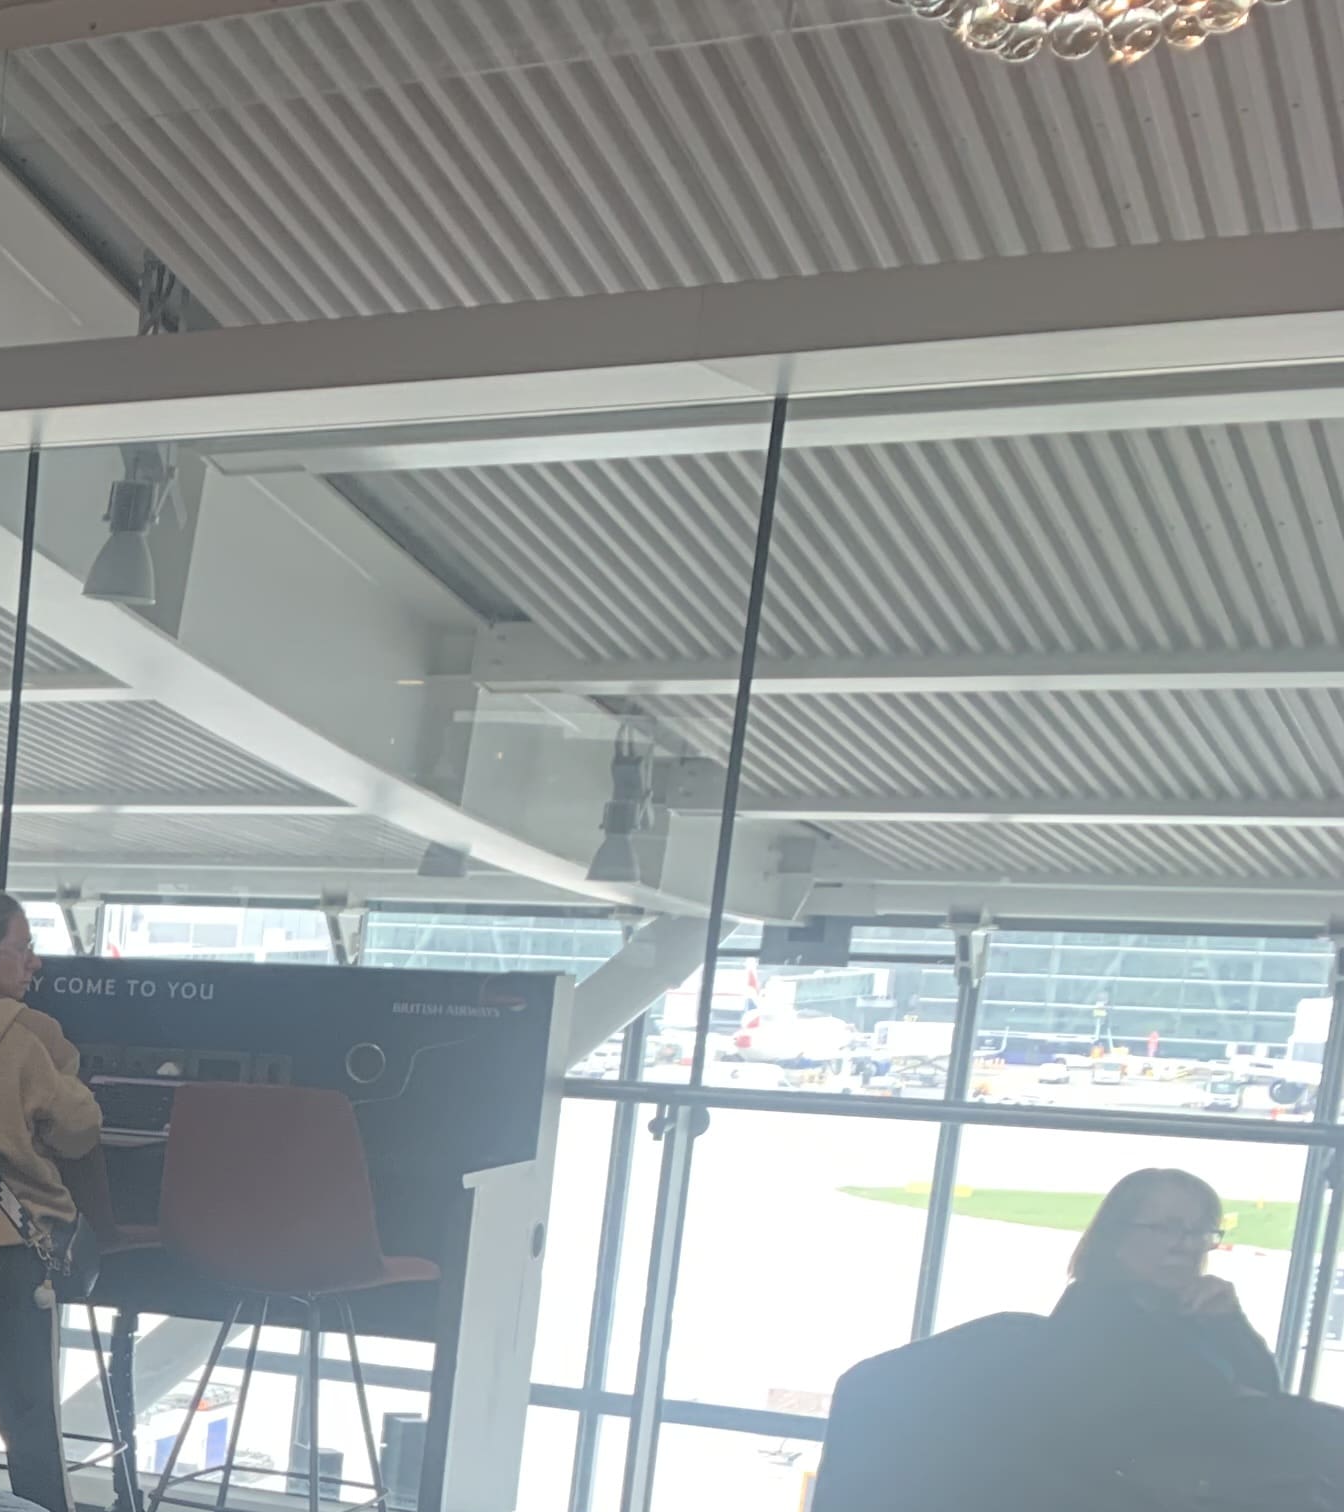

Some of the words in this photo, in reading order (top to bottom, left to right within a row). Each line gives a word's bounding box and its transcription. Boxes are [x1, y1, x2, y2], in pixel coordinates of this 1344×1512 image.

[53, 976, 117, 996] COME
[126, 979, 157, 998] TO
[167, 981, 214, 1001] YOU
